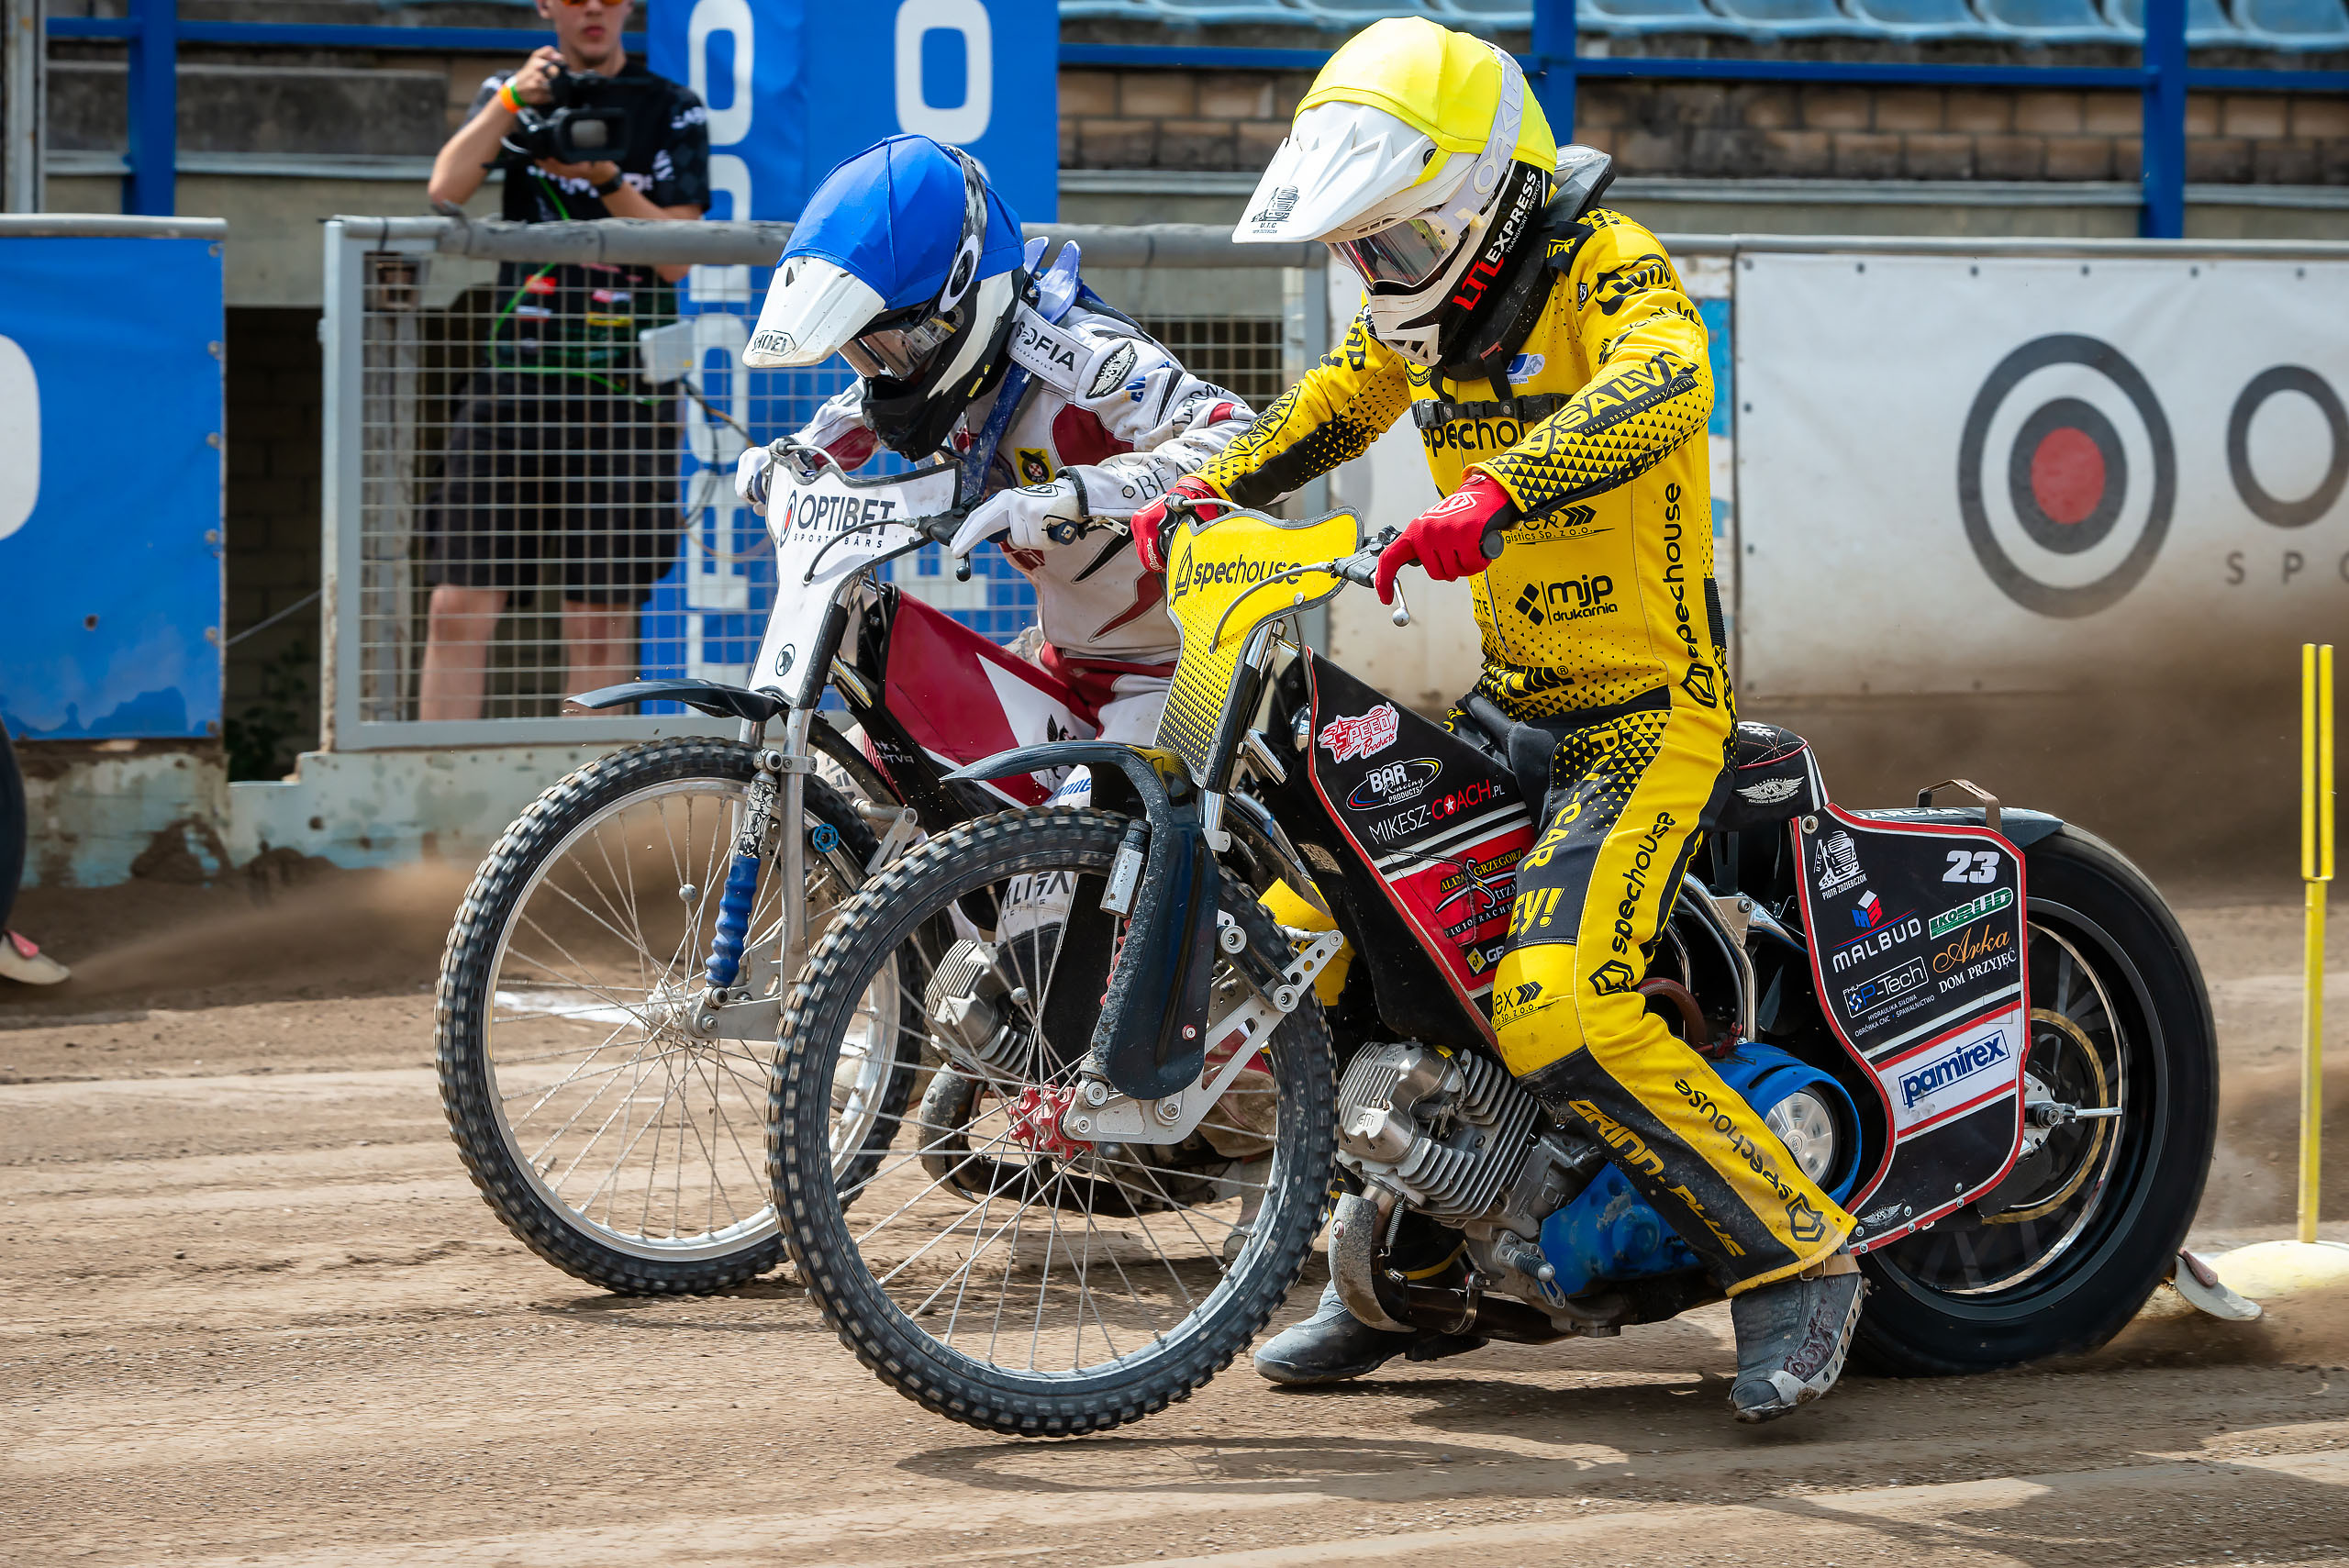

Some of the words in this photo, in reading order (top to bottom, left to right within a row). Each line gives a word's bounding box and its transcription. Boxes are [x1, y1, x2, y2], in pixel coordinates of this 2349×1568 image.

[1486, 170, 1537, 264] EXPRESS
[1505, 217, 1529, 254] TRANSPORT
[1585, 419, 1606, 434] OKNA
[1609, 406, 1636, 423] DRZWI
[1640, 392, 1667, 408] BRAMY
[797, 494, 896, 536] OPTIBET
[794, 533, 836, 544] SPORT
[1505, 531, 1536, 544] gistics
[1193, 554, 1302, 592] spechouse
[1663, 483, 1704, 659] spechouse
[1547, 574, 1614, 608] mjp
[1553, 602, 1619, 623] drukarnia
[1334, 715, 1392, 751] SPEED
[1362, 732, 1395, 756] Products
[1369, 763, 1408, 794] BAR
[1382, 777, 1424, 797] Racing
[1388, 786, 1420, 804] PRODUCTS
[1473, 848, 1525, 877] GRZEGORZ
[1942, 850, 2000, 884] 23
[1611, 811, 1677, 956] spechouse
[1821, 887, 1838, 901] PIOTR
[1478, 903, 1516, 923] RACHU
[1930, 888, 2012, 929] EKOBUD
[1832, 917, 1922, 973] MALBUD
[1932, 924, 2010, 973] Arka
[1938, 972, 1965, 994] DOM
[1967, 947, 2018, 981] PRZYJĘĆ
[1854, 1020, 1880, 1037] OBRÓBKA
[1879, 1015, 1891, 1026] CNC
[1895, 994, 1936, 1018] SPAWALNICTWO
[1867, 1003, 1898, 1022] HYDRAULIKA
[1902, 1036, 2007, 1109] pamirex
[1674, 1078, 1794, 1201] spechouse
